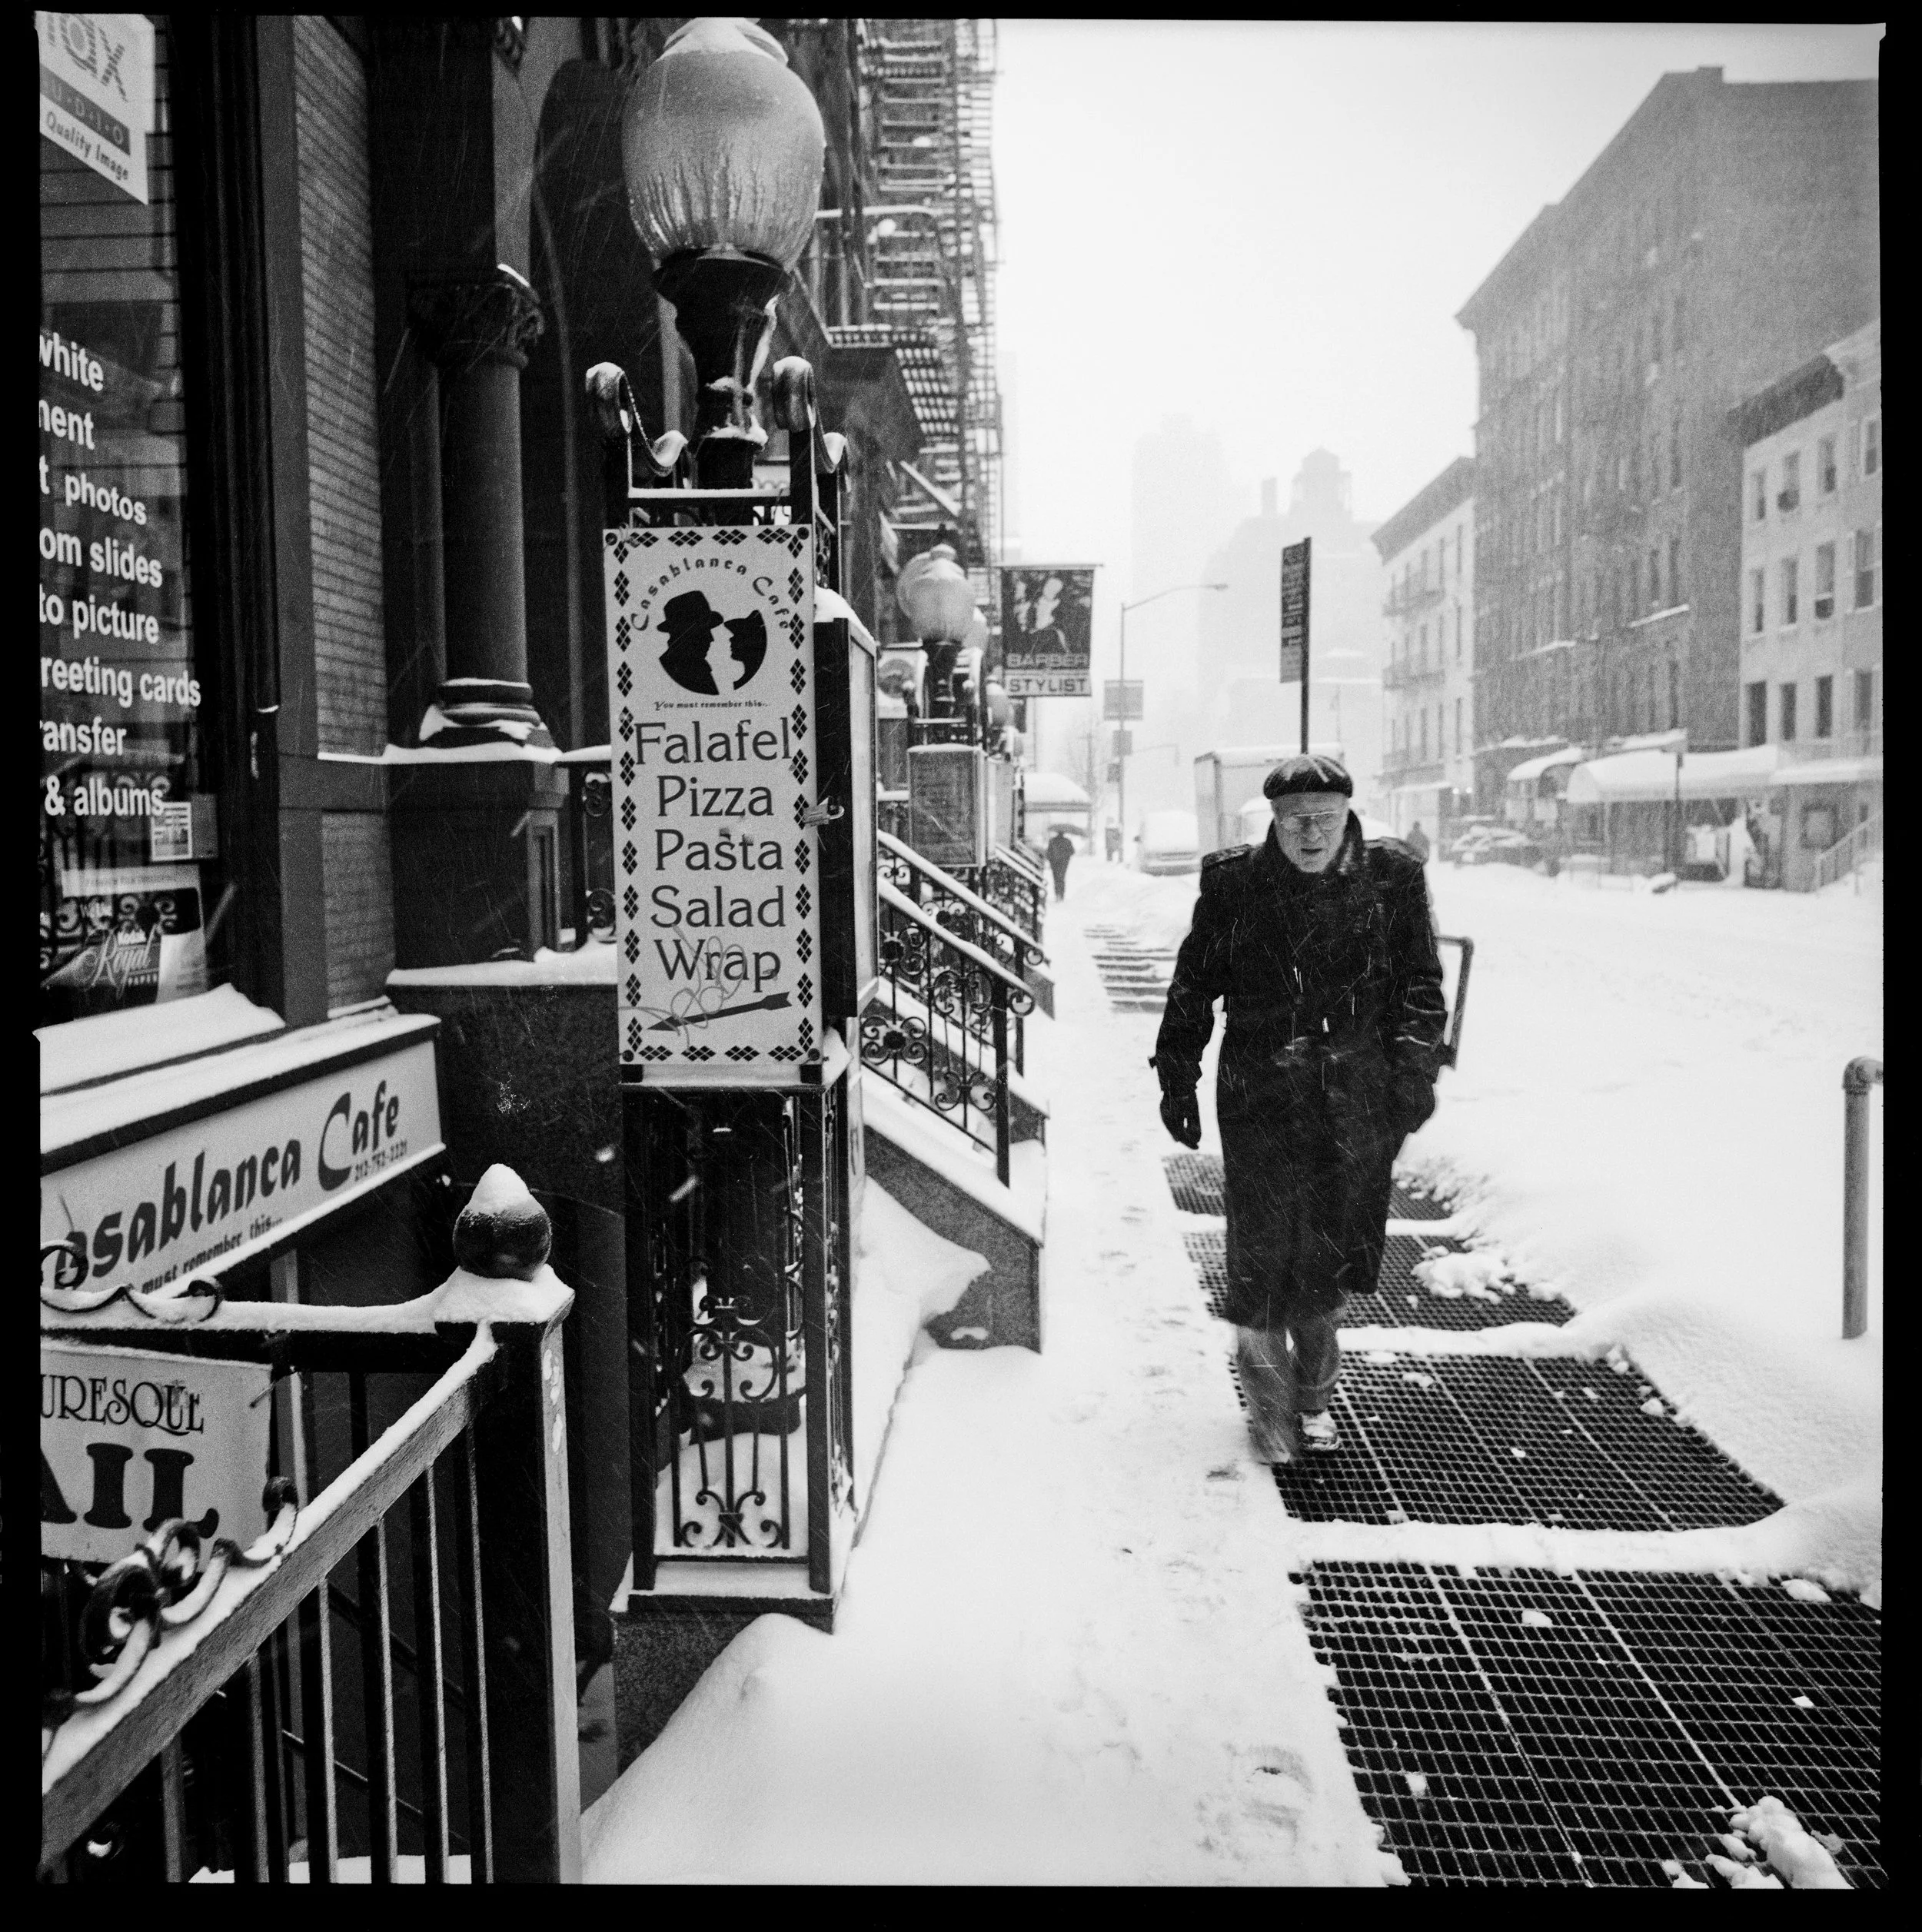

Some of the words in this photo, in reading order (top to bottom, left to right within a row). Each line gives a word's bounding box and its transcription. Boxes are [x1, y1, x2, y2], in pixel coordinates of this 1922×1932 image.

[46, 111, 91, 158] Quality
[95, 144, 129, 181] Image
[65, 472, 146, 525] photos
[39, 527, 81, 567] om
[90, 537, 162, 587] slides
[39, 584, 64, 625] to
[72, 594, 159, 643] picture
[630, 557, 747, 631] Casablanca
[752, 576, 790, 630] Cafe
[41, 656, 132, 708] reeting
[140, 670, 201, 707] cards
[1006, 653, 1088, 667] BARBER
[653, 701, 673, 711] You
[700, 700, 742, 709] remember
[1009, 677, 1086, 693] STYLIST
[39, 716, 126, 756] ansfer
[633, 717, 793, 765] Falafel
[45, 775, 65, 816] &
[74, 777, 165, 816] albums
[657, 775, 775, 817] Pizza
[654, 828, 784, 871] Pasta
[650, 884, 786, 929] Salad
[653, 939, 781, 993] Wrap
[318, 1079, 400, 1191] Cafe
[183, 1232, 243, 1273] remember
[40, 1374, 204, 1435] URESQUE
